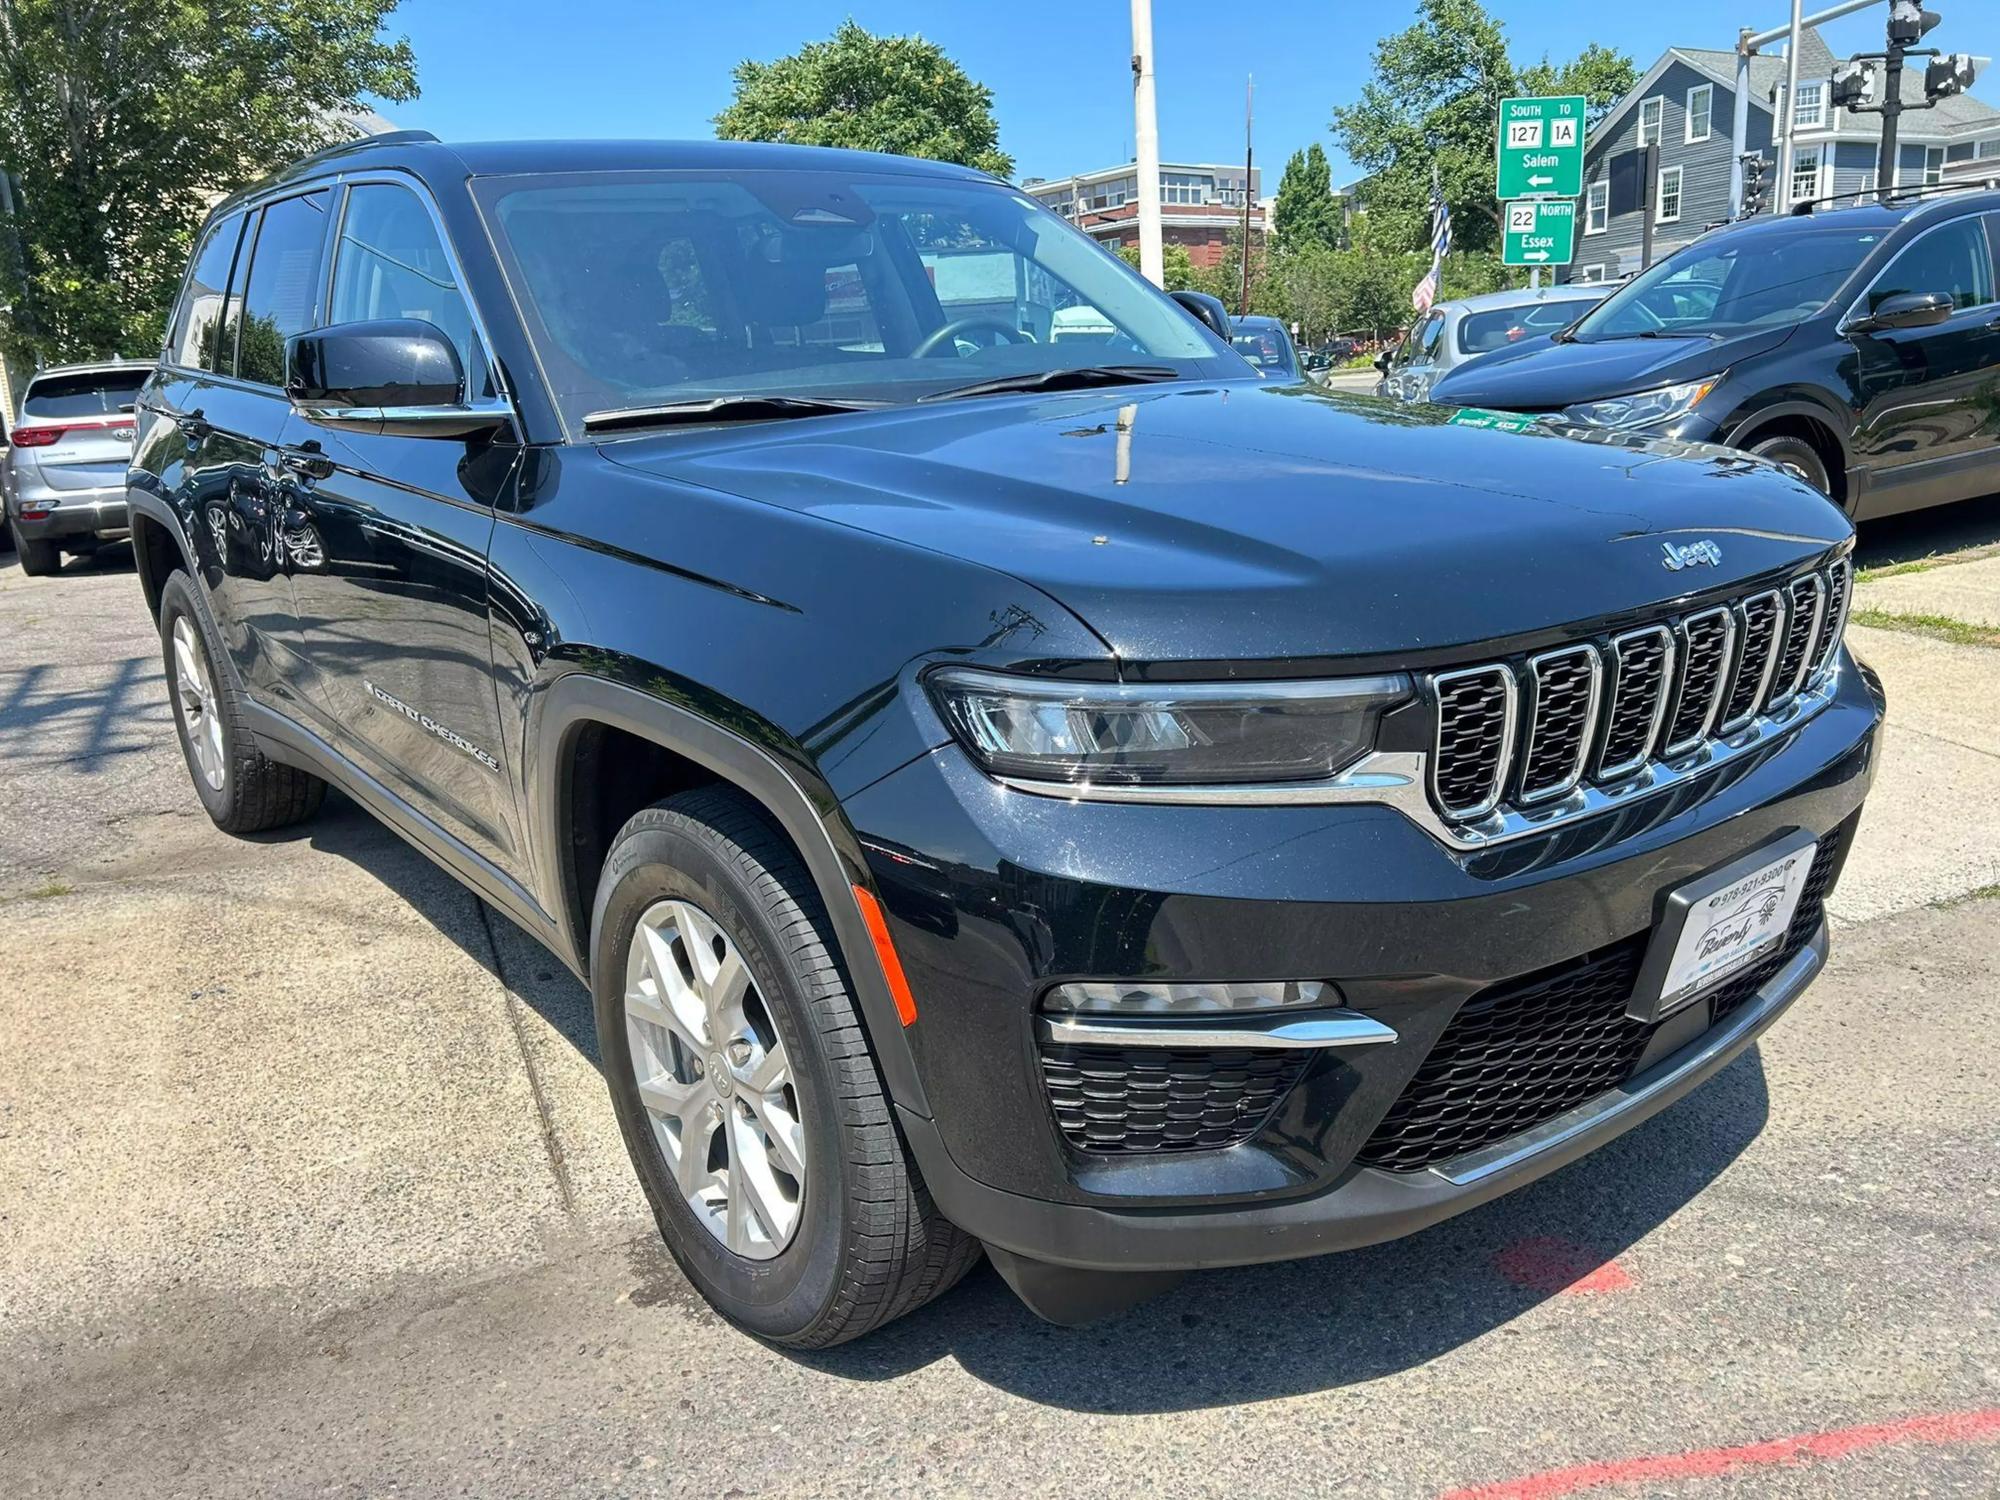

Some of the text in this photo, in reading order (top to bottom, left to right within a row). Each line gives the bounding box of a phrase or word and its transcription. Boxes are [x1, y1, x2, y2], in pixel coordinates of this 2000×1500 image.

[1510, 104, 1571, 117] SOUTH TO
[1511, 126, 1572, 142] 127 1A
[1522, 154, 1559, 168] Salem
[1512, 205, 1572, 226] 22 NORTH
[1521, 234, 1554, 248] Essex
[1661, 540, 1722, 571] Jeep
[421, 715, 501, 773] CHEROKEE
[1719, 865, 1784, 906] 978-921-9300
[1698, 917, 1753, 960] Beverly
[737, 925, 806, 1074] MICHELIN
